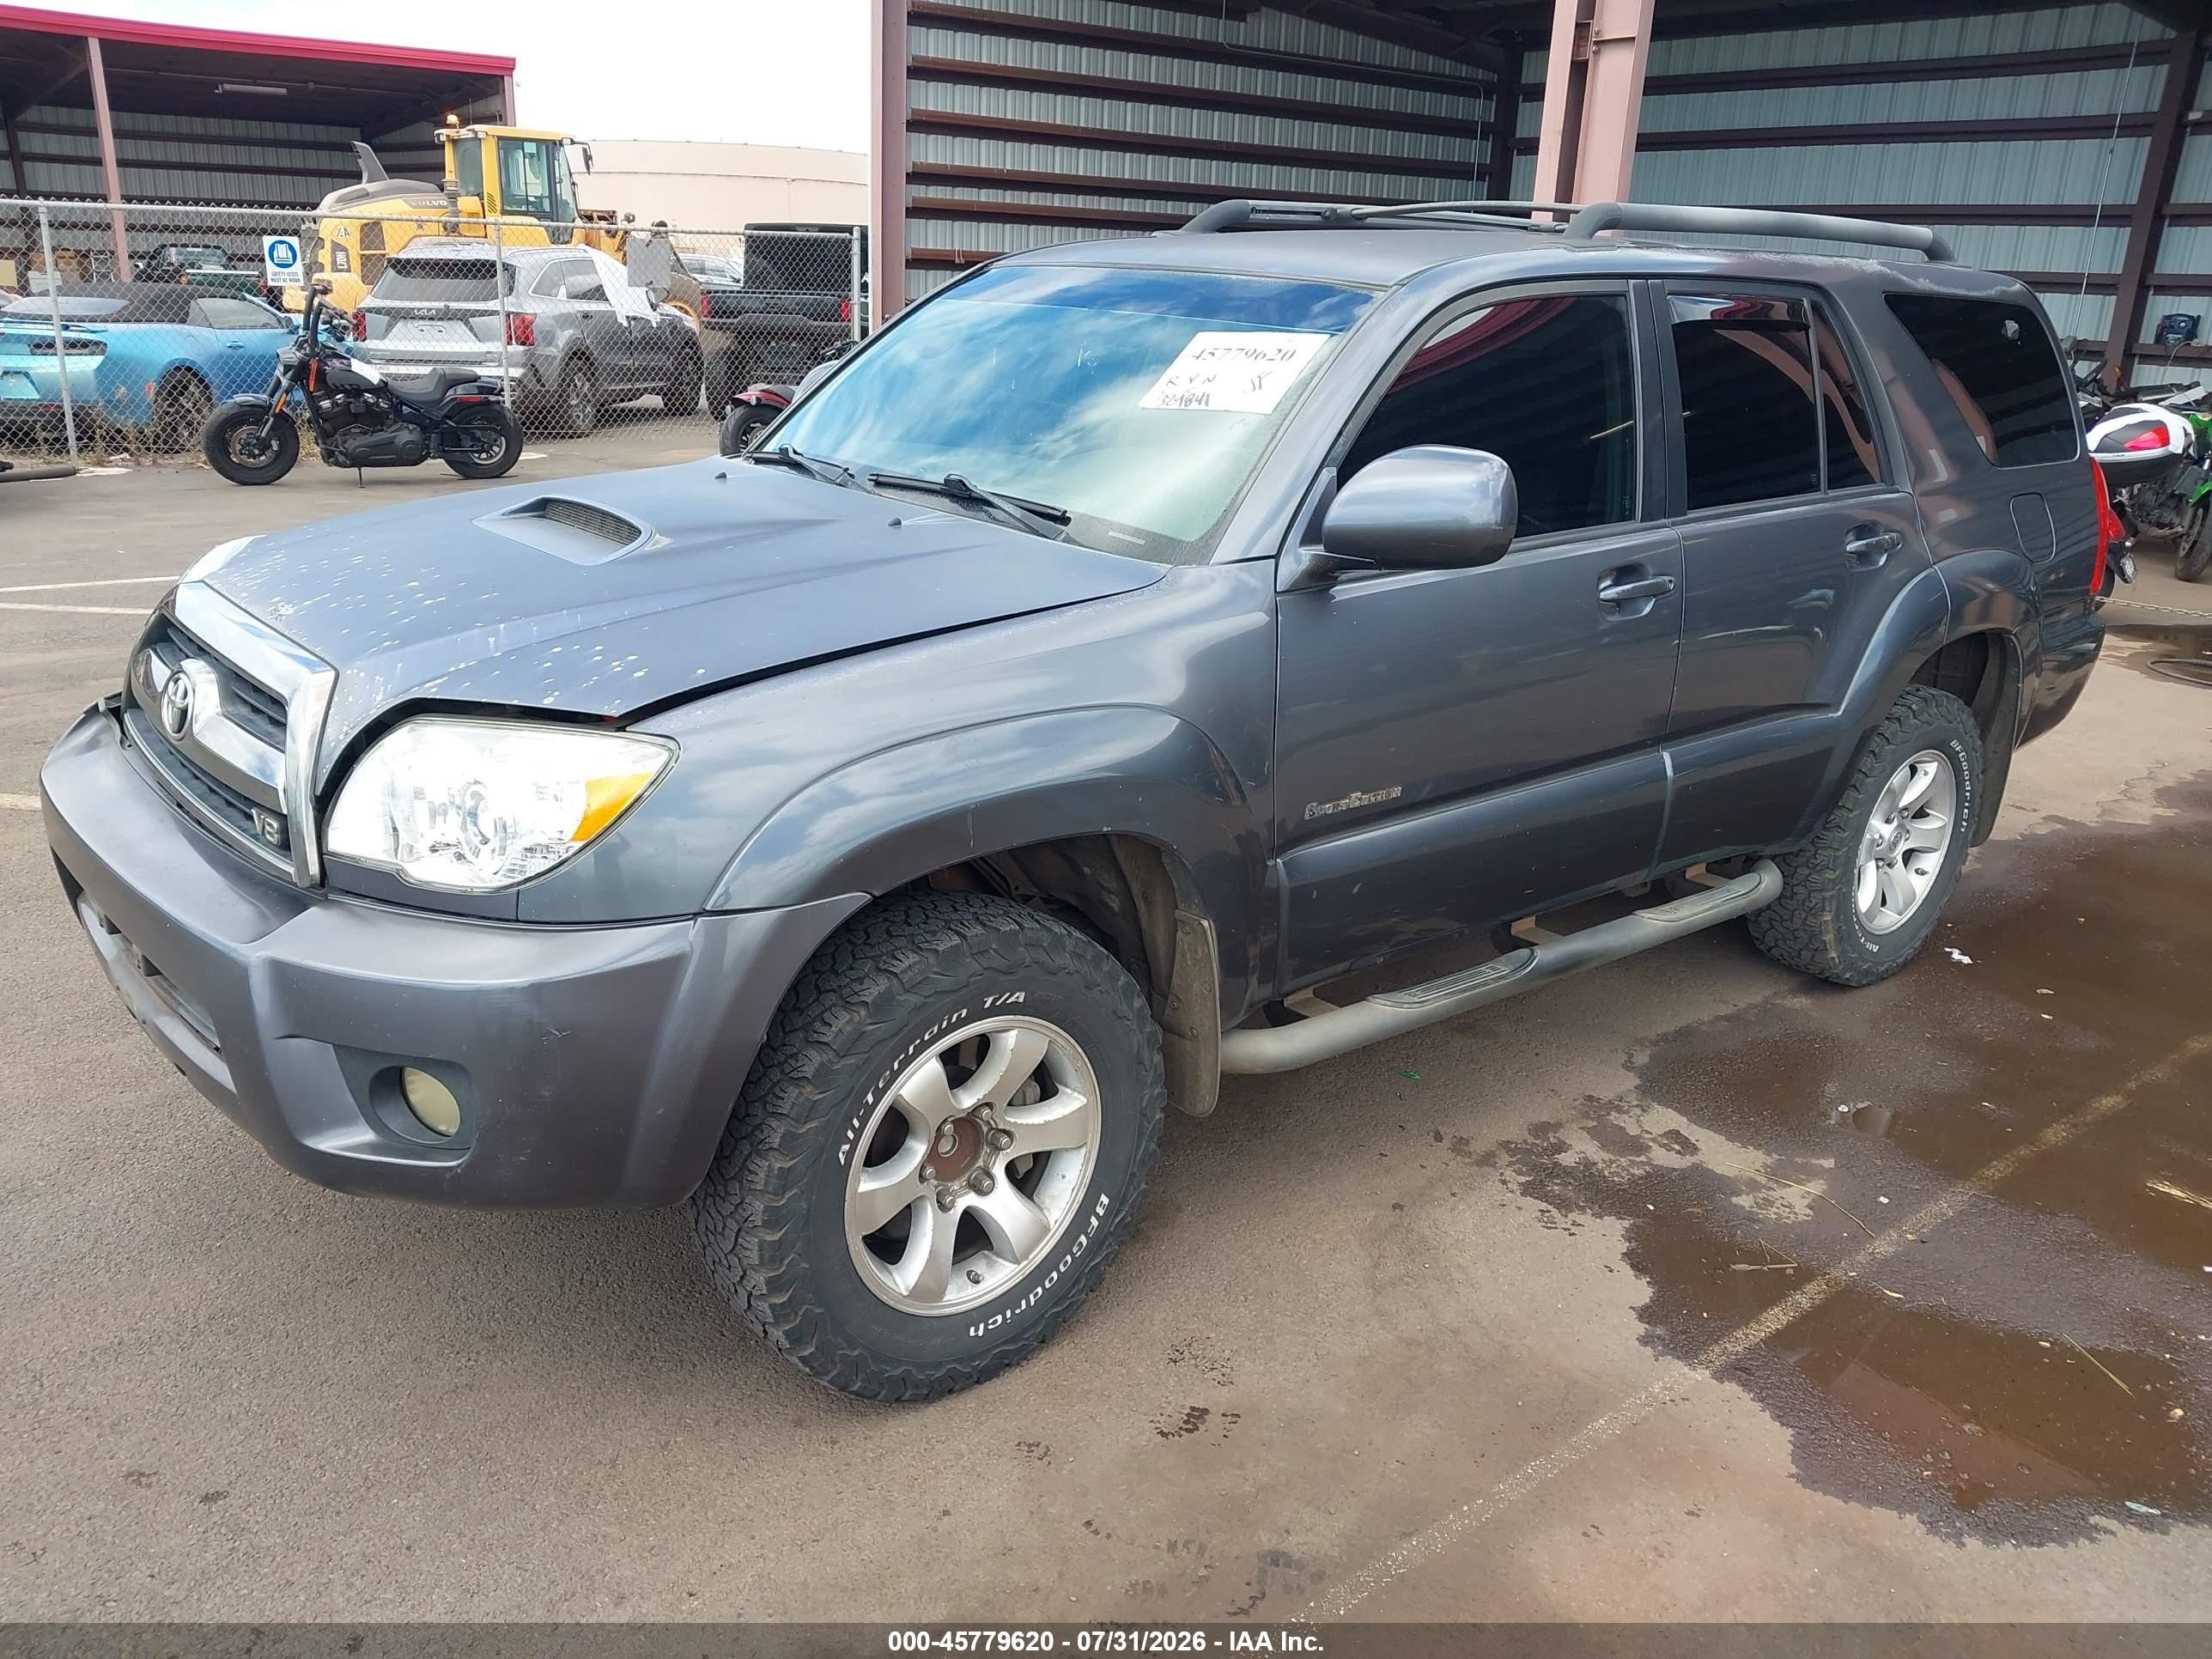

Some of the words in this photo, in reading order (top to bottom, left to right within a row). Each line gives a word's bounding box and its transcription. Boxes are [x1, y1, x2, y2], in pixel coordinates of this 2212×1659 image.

[251, 807, 281, 846] V8
[1950, 738, 1972, 833] BFGoodrich
[837, 1007, 969, 1167] All-Terrain
[981, 991, 1026, 1009] T/A
[969, 1192, 1110, 1338] BFGoodrich
